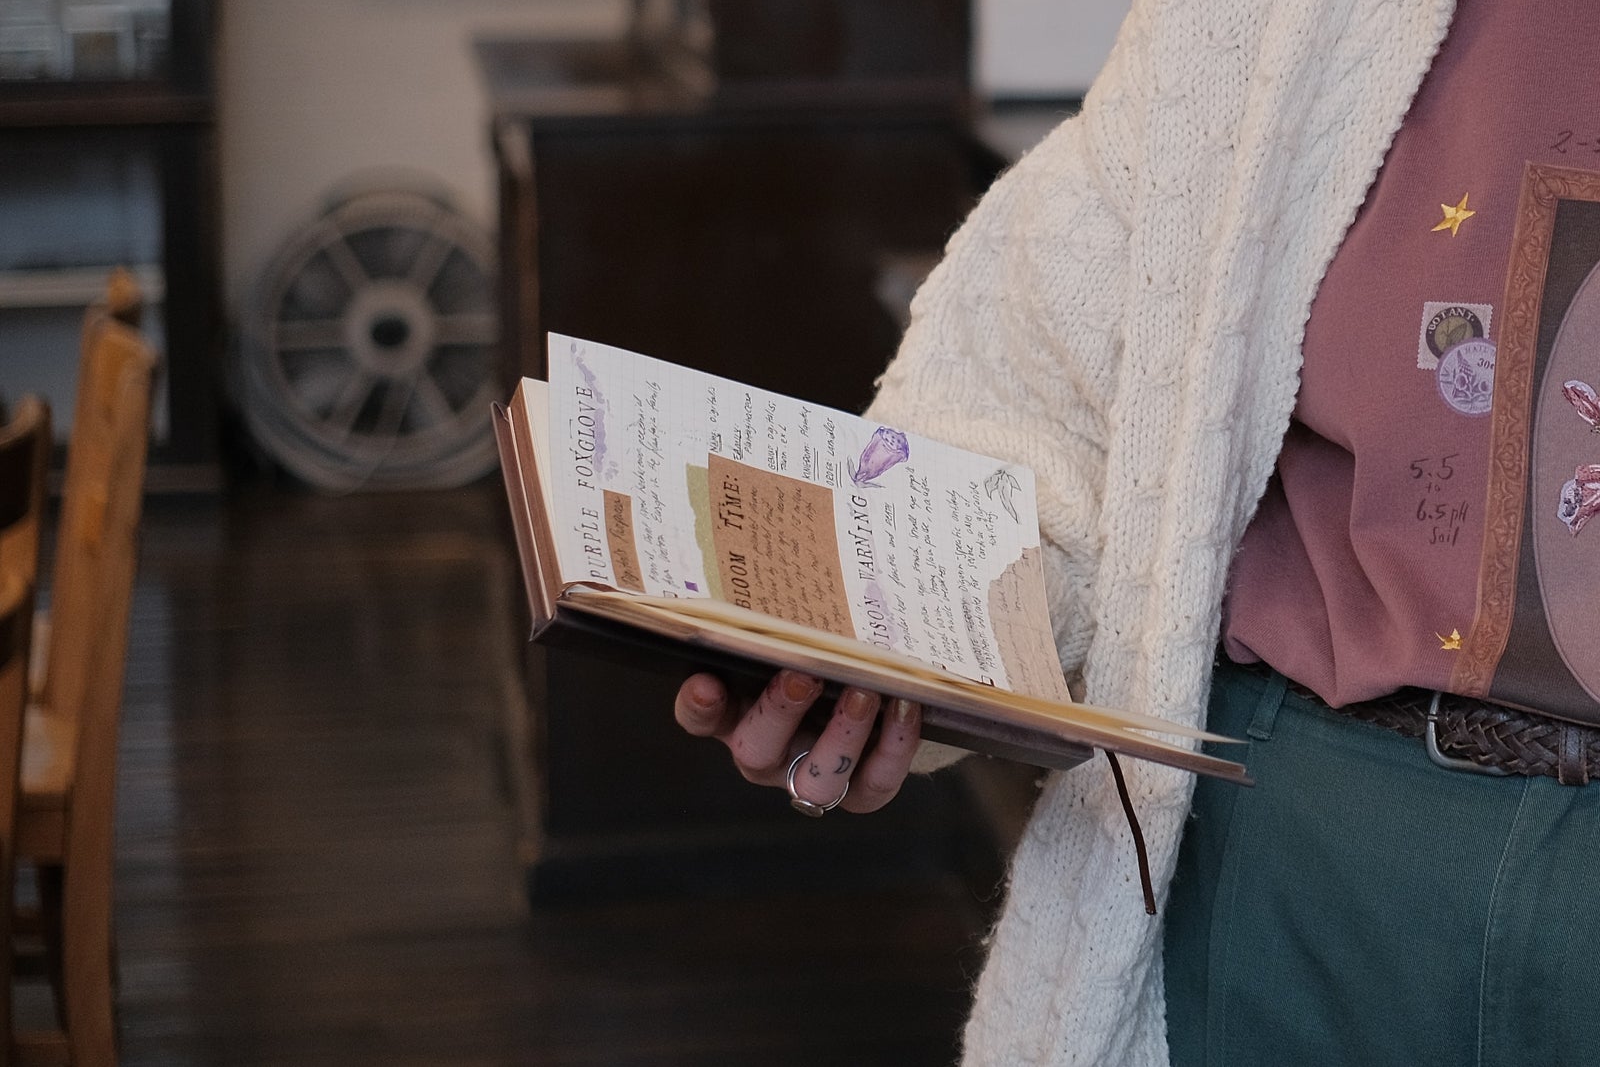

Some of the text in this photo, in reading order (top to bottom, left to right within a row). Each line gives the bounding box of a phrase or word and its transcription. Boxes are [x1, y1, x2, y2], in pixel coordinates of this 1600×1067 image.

[572, 385, 608, 581] PURPLE FOXGLOVE
[1410, 453, 1460, 480] 5.5
[1425, 481, 1441, 493] to
[722, 474, 752, 611] BLOOM TIME:
[1416, 498, 1469, 528] 6.5 pH
[850, 493, 892, 651] OISON WARNING
